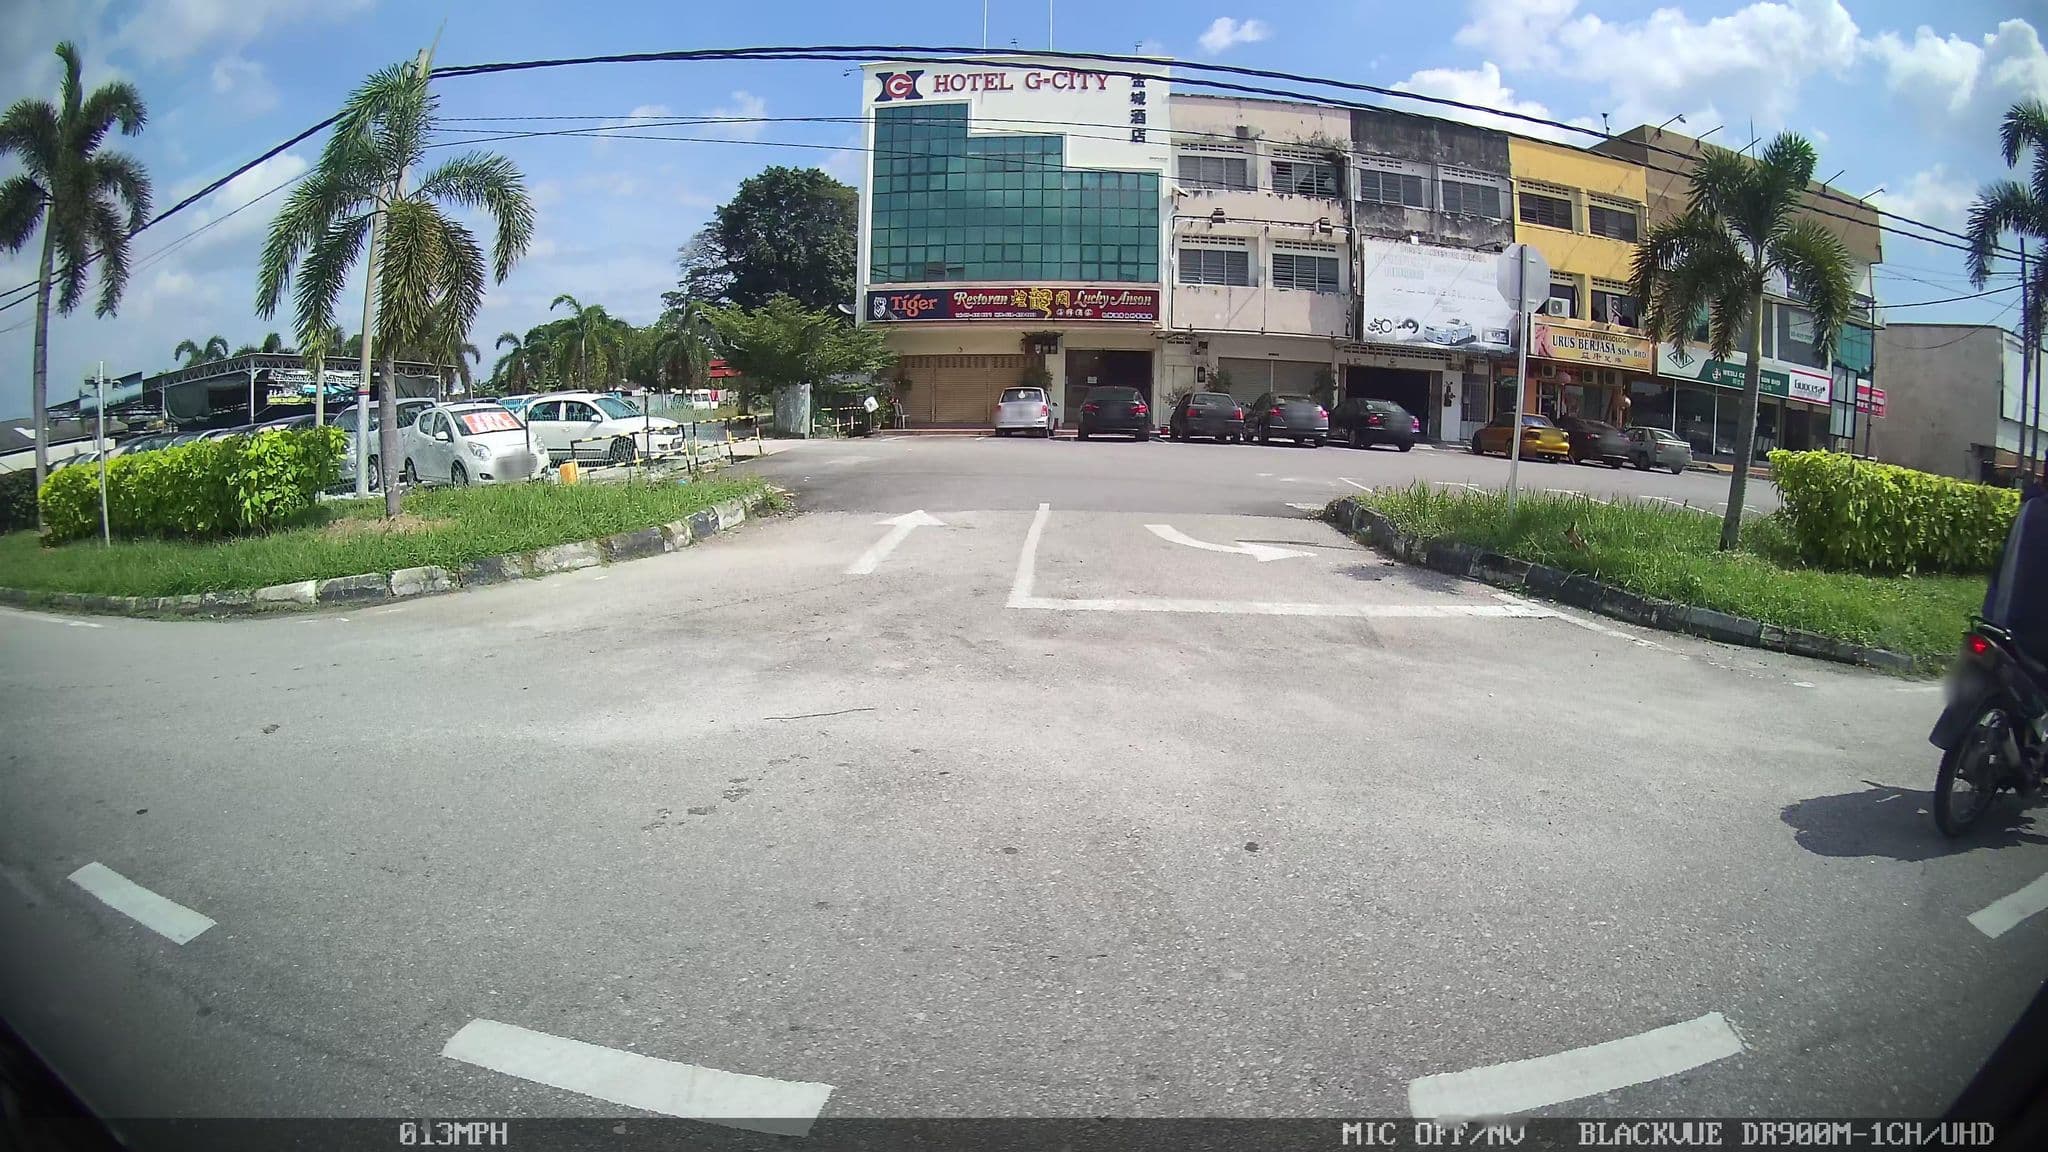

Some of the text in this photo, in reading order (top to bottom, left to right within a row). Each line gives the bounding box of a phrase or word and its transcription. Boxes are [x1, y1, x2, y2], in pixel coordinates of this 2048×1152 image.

[933, 71, 1111, 93] HOTEL G-CITY
[890, 293, 938, 317] Tiger
[953, 291, 1008, 309] Restoran
[1073, 290, 1152, 308] Lucky Anson
[1552, 334, 1575, 349] URUS
[1578, 338, 1616, 354] BERJASA
